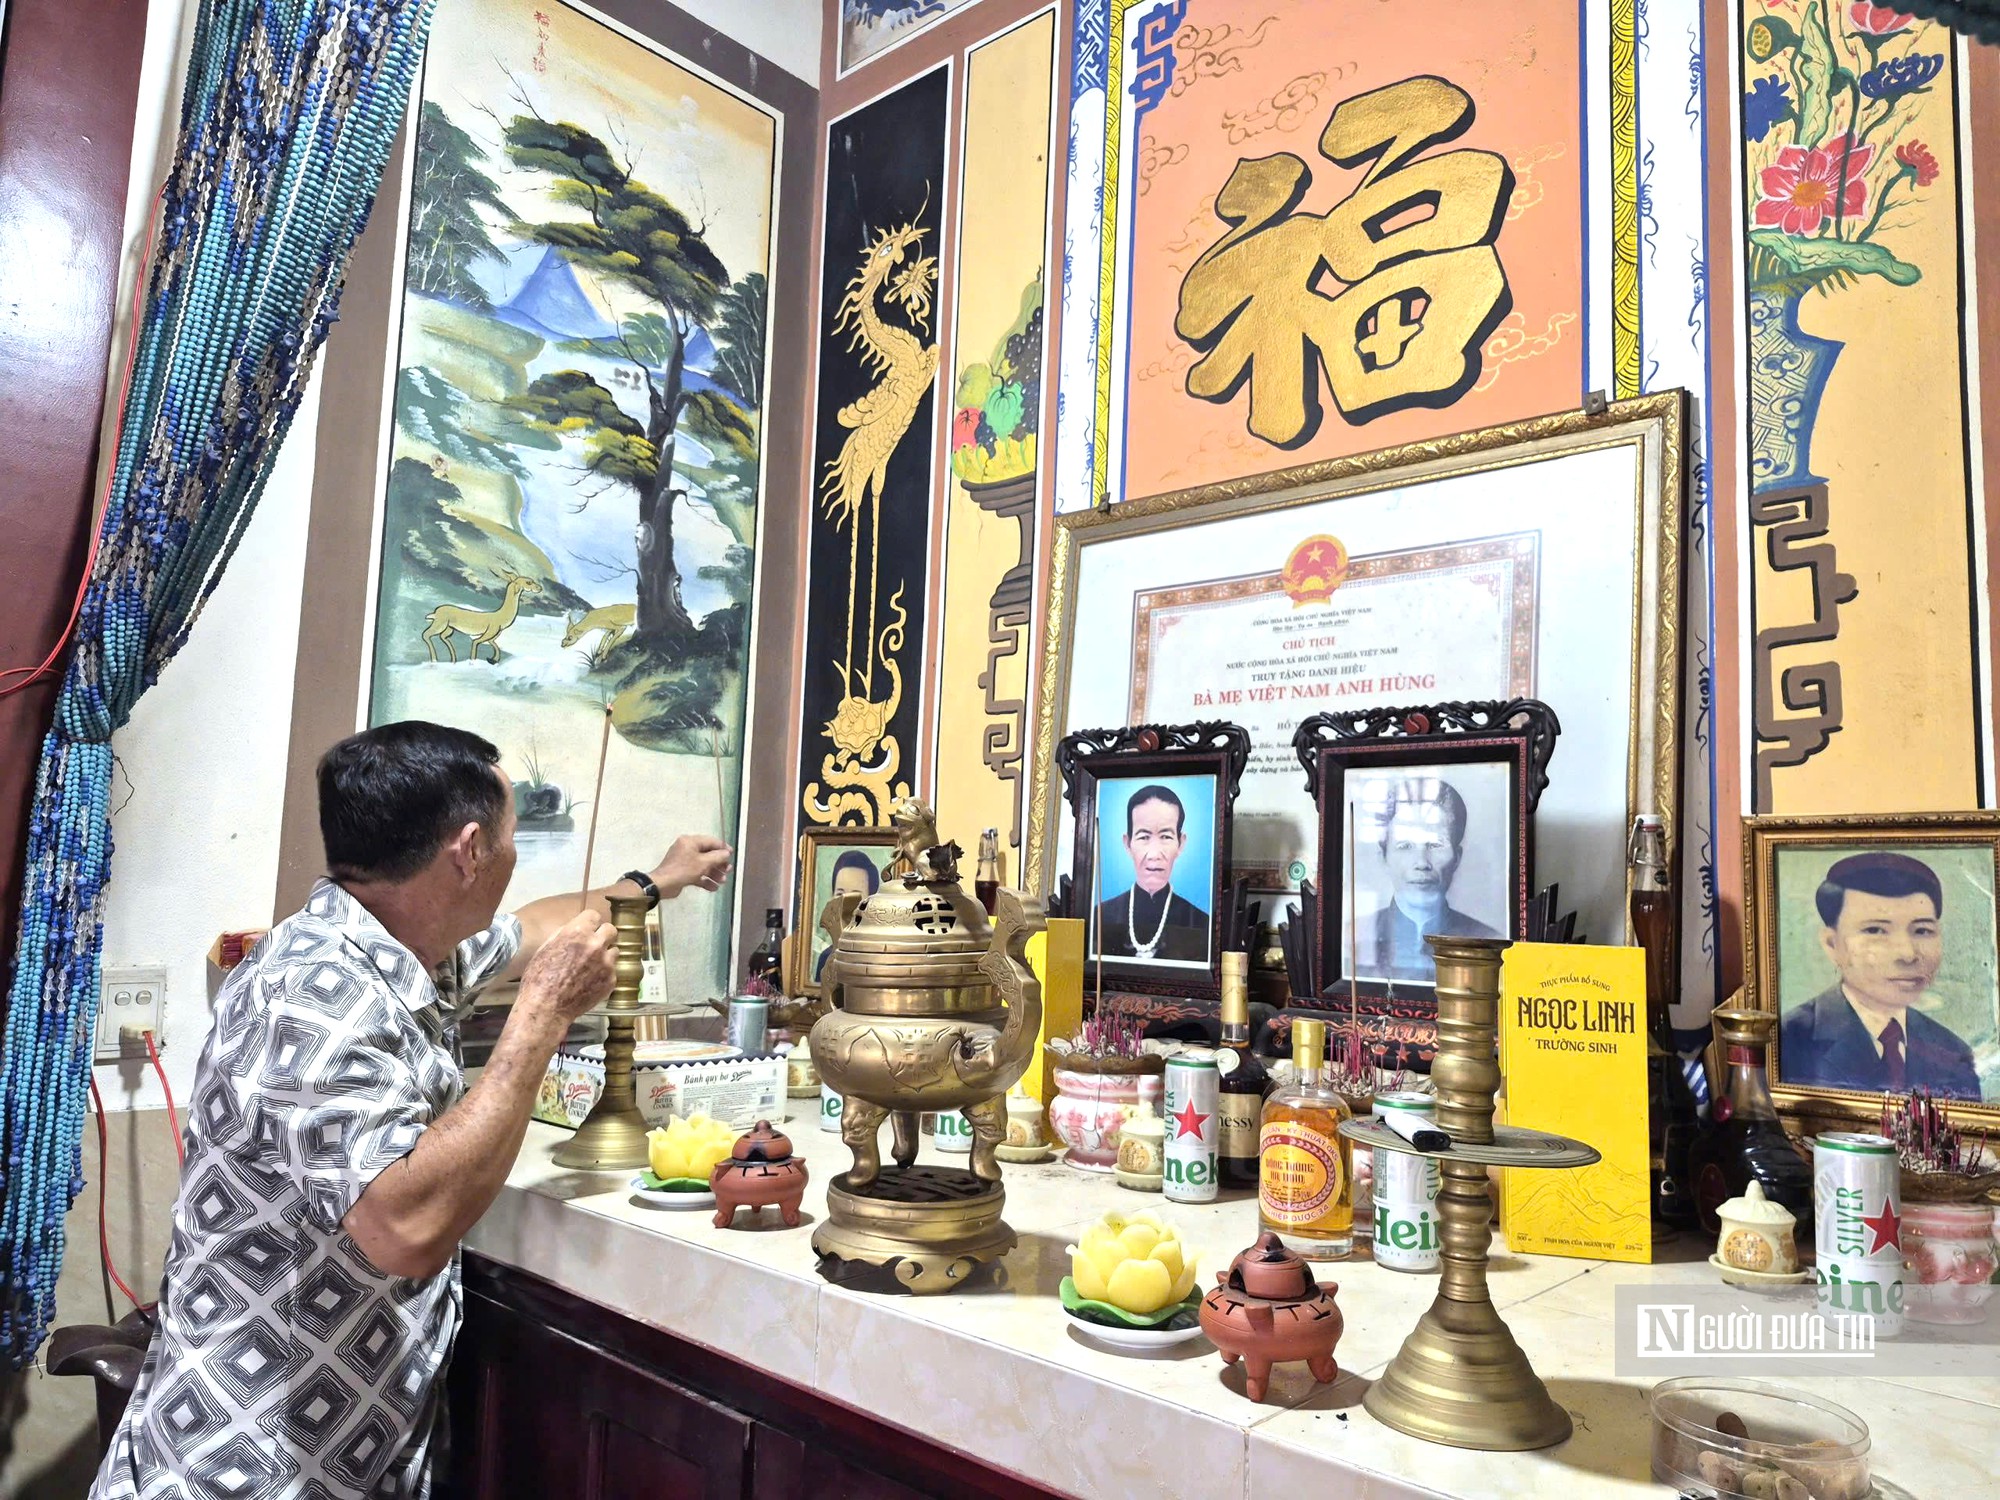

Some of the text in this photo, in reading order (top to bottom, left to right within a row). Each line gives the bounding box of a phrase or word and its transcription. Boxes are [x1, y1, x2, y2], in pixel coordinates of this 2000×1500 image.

[1174, 74, 1516, 450] 福
[1282, 636, 1336, 650] CHỦ TỊCH
[1247, 659, 1267, 669] CỘNG
[1269, 657, 1284, 666] HÒA
[1298, 654, 1312, 664] HỘI
[1313, 651, 1330, 661] CHỦ
[1332, 650, 1358, 660] NGHĨA
[1359, 648, 1379, 657] VIỆT
[1380, 647, 1398, 655] NAM
[1251, 663, 1367, 682] TRUY TẶNG DANH HIỆU
[1193, 671, 1436, 706] BÀ MẸ VIỆT NAM ANH HÙNG
[1592, 980, 1611, 992] SUNG
[1517, 996, 1635, 1034] NGỌC LINH
[1535, 1038, 1617, 1054] TRƯỜNG SINH
[684, 1073, 704, 1085] Bánh
[705, 1075, 717, 1085] quy
[1165, 1090, 1175, 1142] SILVER
[1836, 1186, 1865, 1258] SILVER
